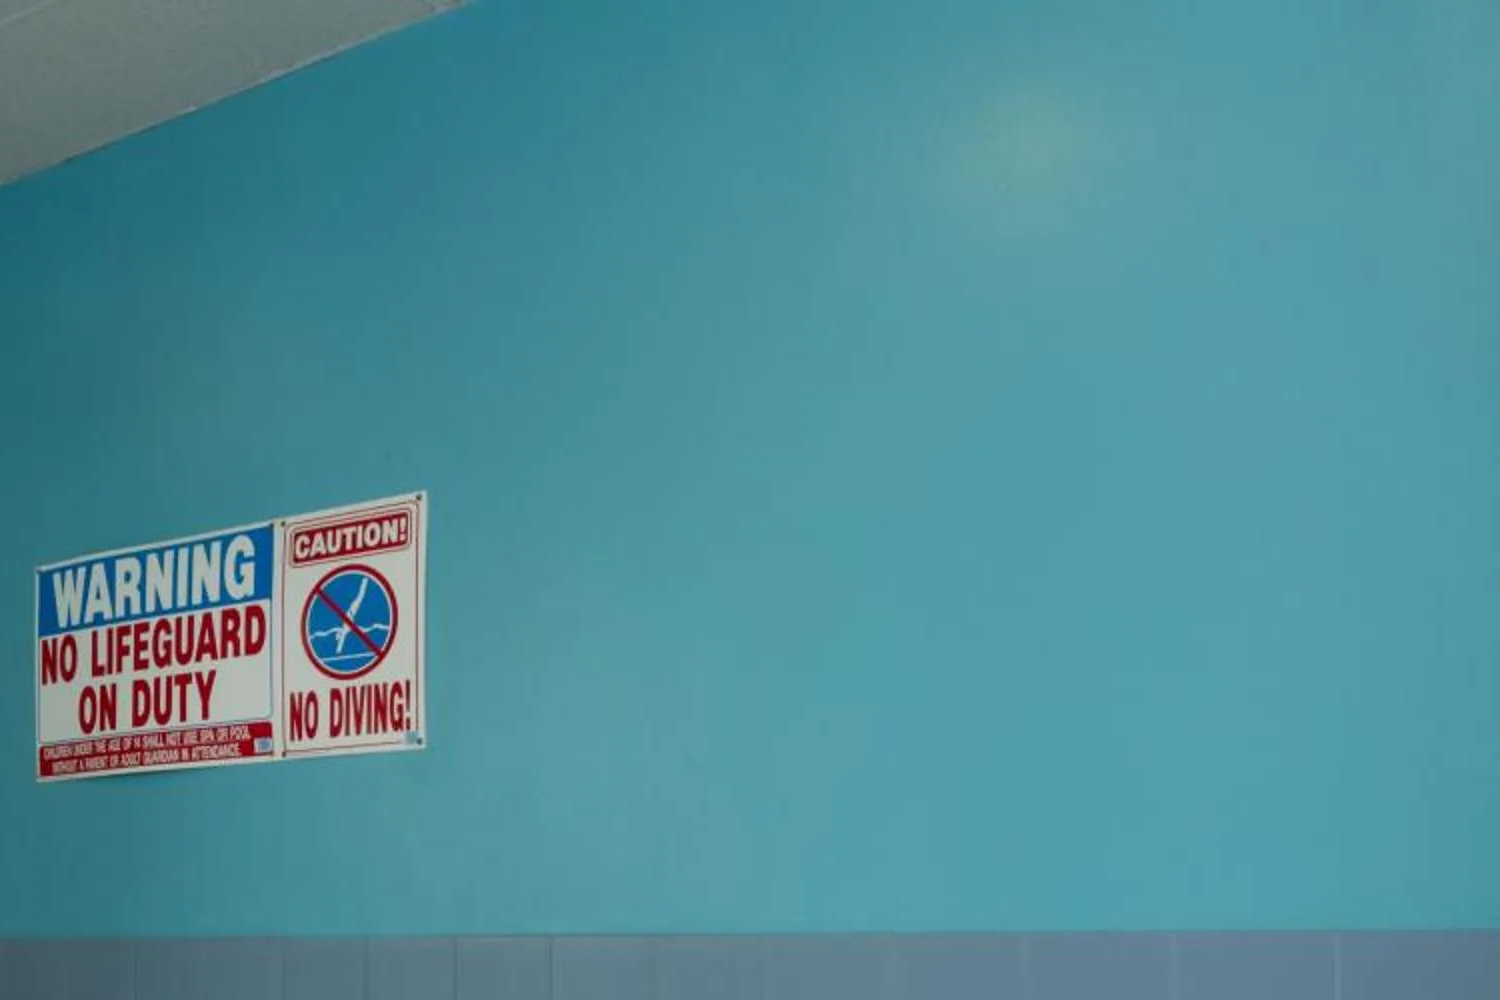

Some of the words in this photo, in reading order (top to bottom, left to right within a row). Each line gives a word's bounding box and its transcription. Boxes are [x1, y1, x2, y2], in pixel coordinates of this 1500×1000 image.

[295, 517, 407, 559] CAUTION!
[52, 535, 256, 629] WARNING
[41, 635, 78, 686] NO
[91, 605, 266, 677] LIFEGUARD
[78, 684, 117, 735] ON
[131, 670, 216, 727] DUTY
[230, 725, 252, 741] POOL
[289, 691, 319, 742] NO
[329, 679, 412, 738] DIVING!
